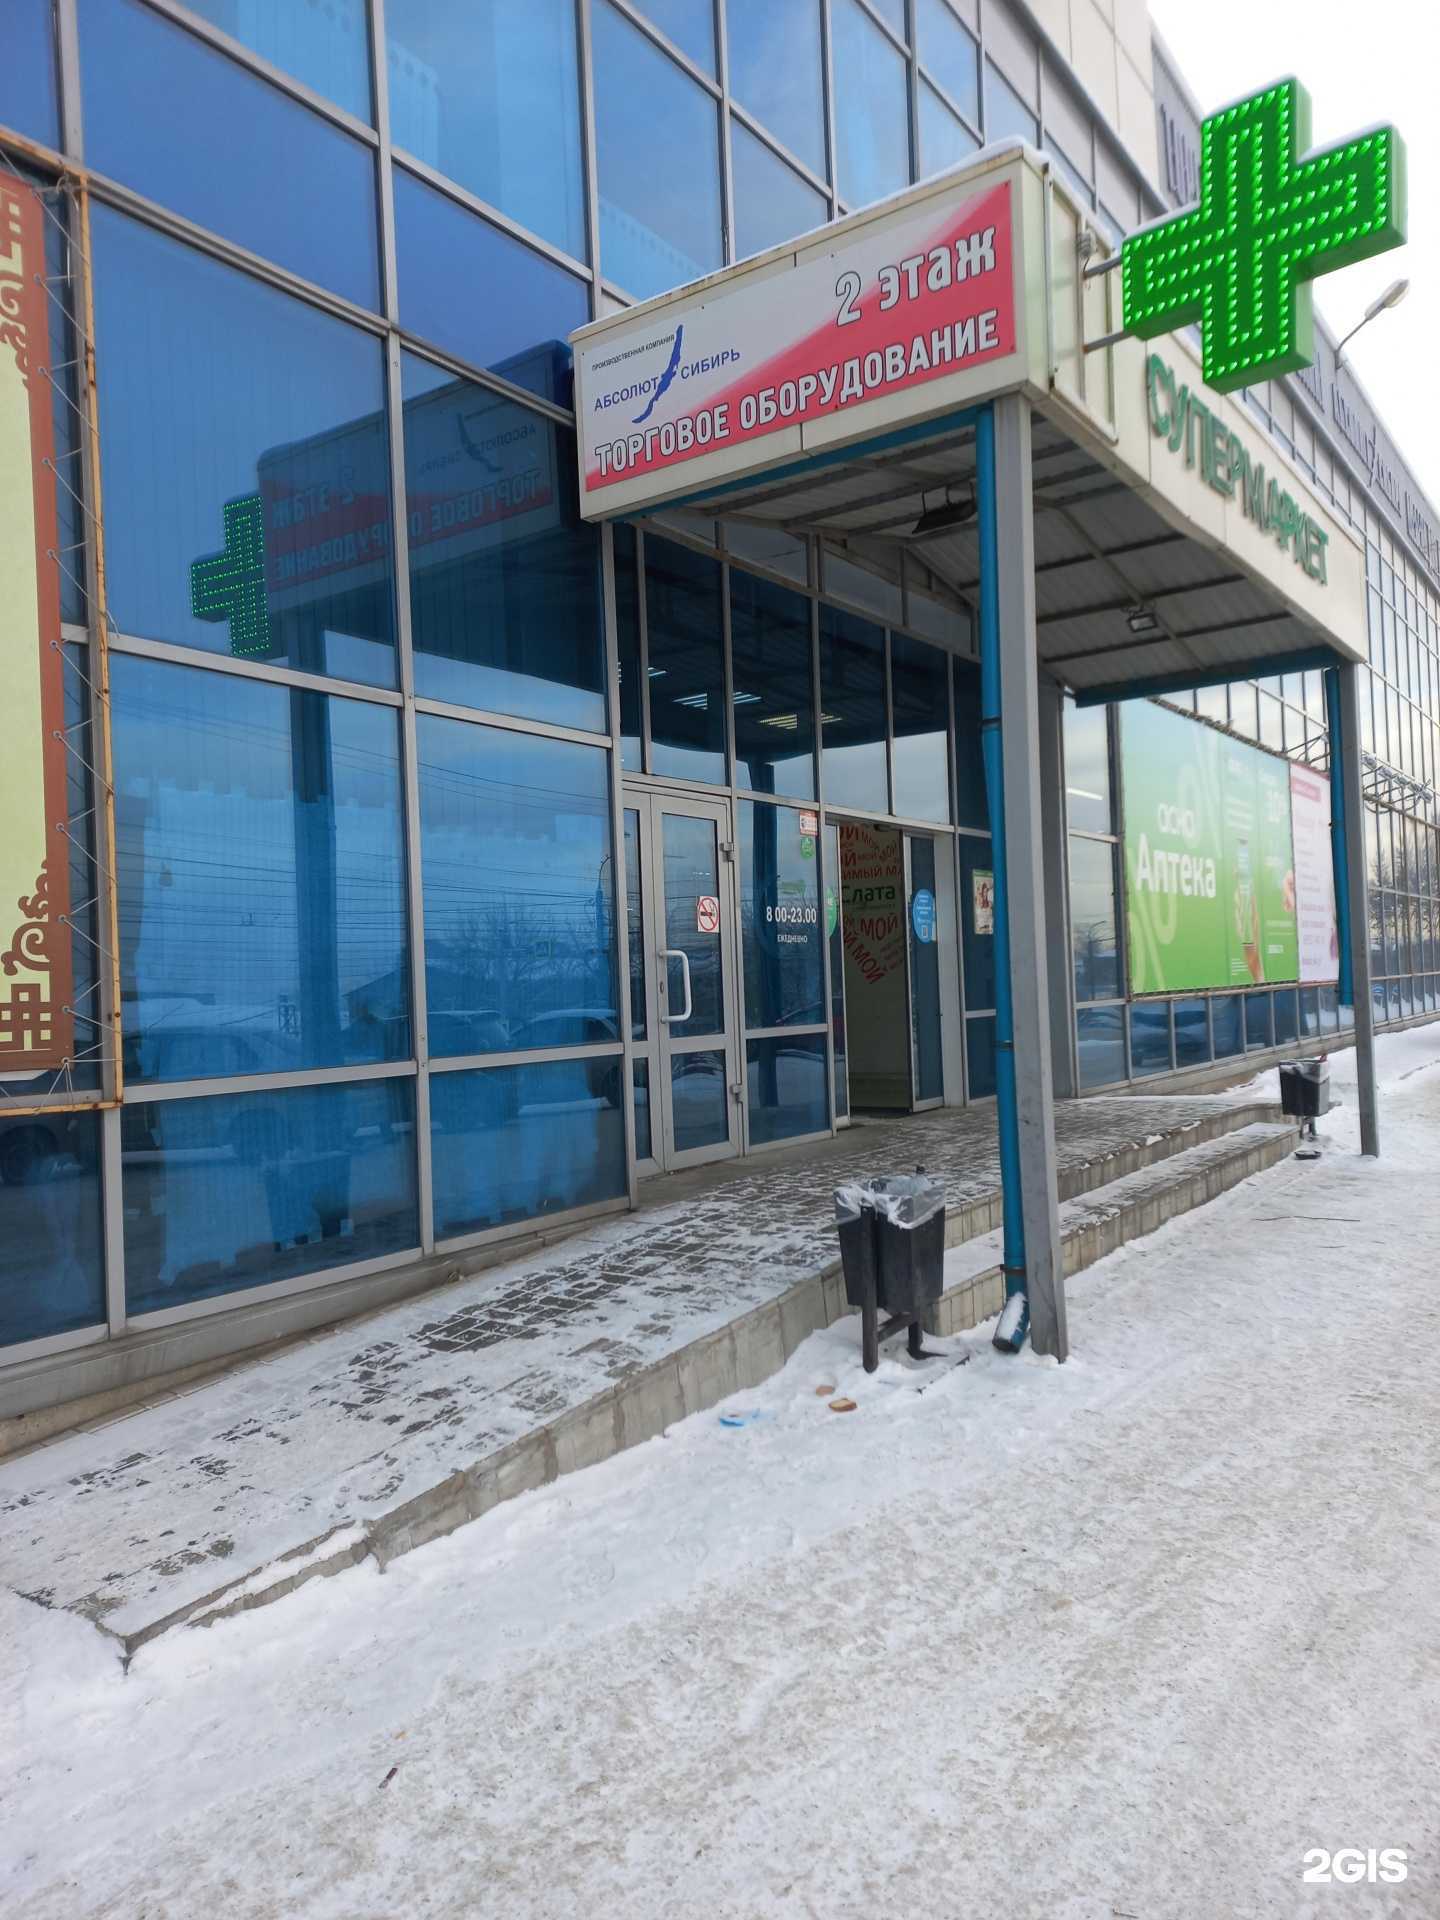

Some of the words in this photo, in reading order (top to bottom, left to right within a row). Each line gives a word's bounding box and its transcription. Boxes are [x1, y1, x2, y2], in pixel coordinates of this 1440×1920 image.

[835, 271, 862, 326] 2
[878, 226, 997, 310] этаж
[592, 346, 645, 371] ПРОИЗВОДСТВЕННАЯ
[645, 334, 675, 351] КОМПАНИЯ
[594, 376, 659, 411] АБСОЛЮТ
[680, 348, 741, 380] СИБИРЬ
[594, 404, 730, 477] ТОРГОВОЕ
[739, 308, 1000, 429] ОБОРУДОВАНИЕ
[1147, 353, 1328, 587] СУПЕРМАРКЕТ
[1136, 832, 1216, 898] Аптека
